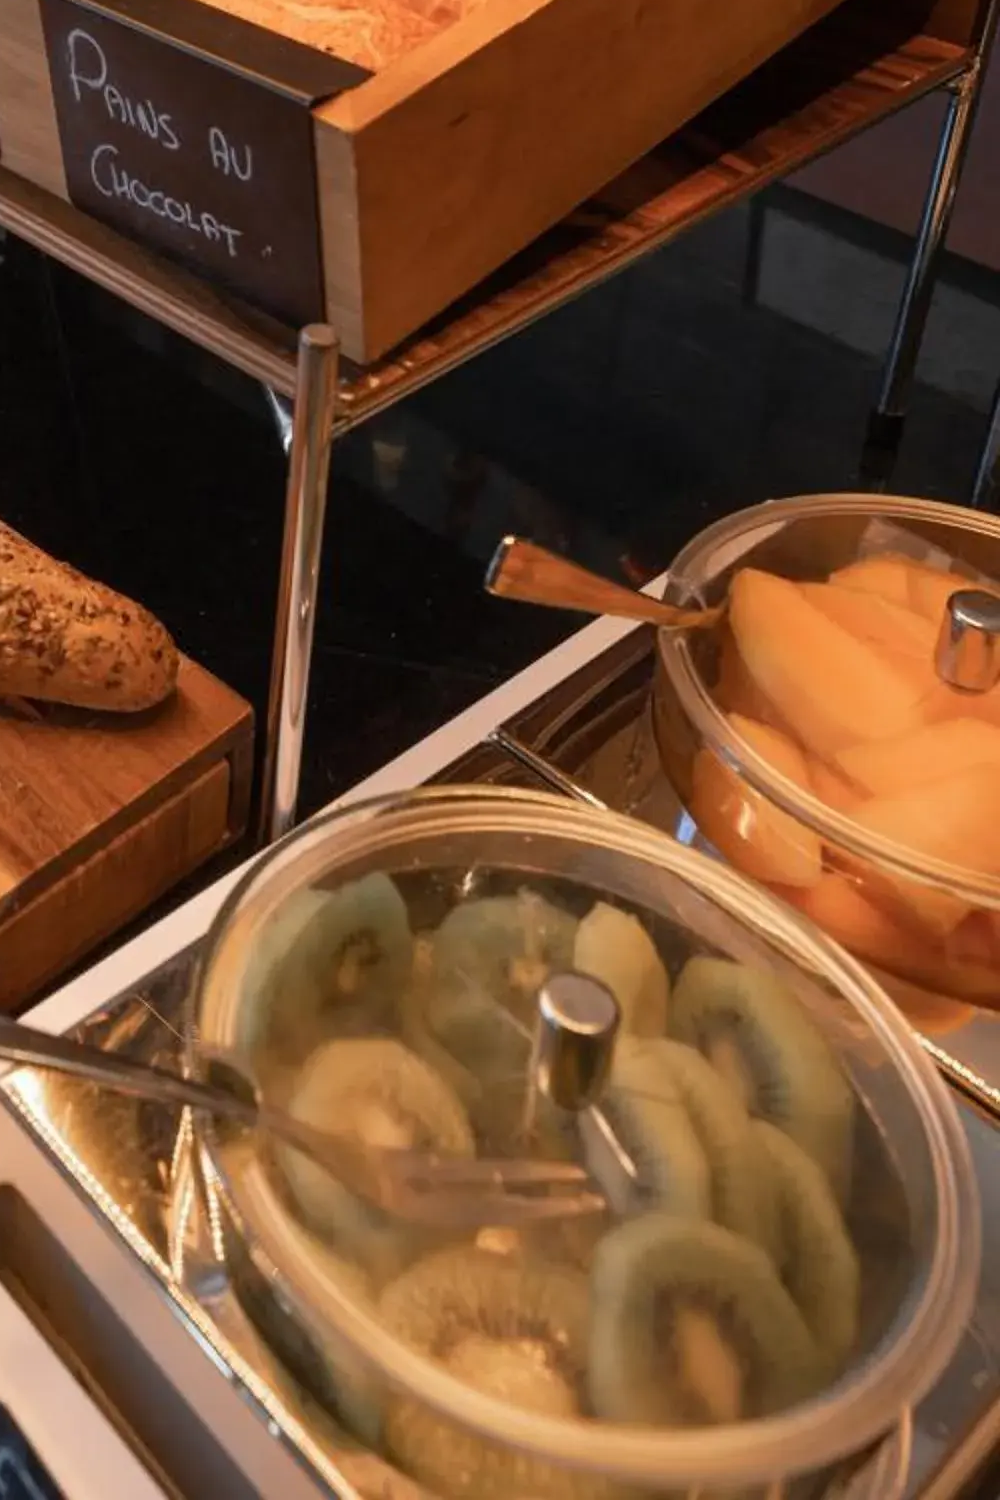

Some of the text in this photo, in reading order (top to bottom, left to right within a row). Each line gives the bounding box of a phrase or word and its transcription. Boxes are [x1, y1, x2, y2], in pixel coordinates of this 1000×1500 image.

[67, 28, 253, 182] PAINS AU
[90, 143, 244, 257] CHOCOLAT
